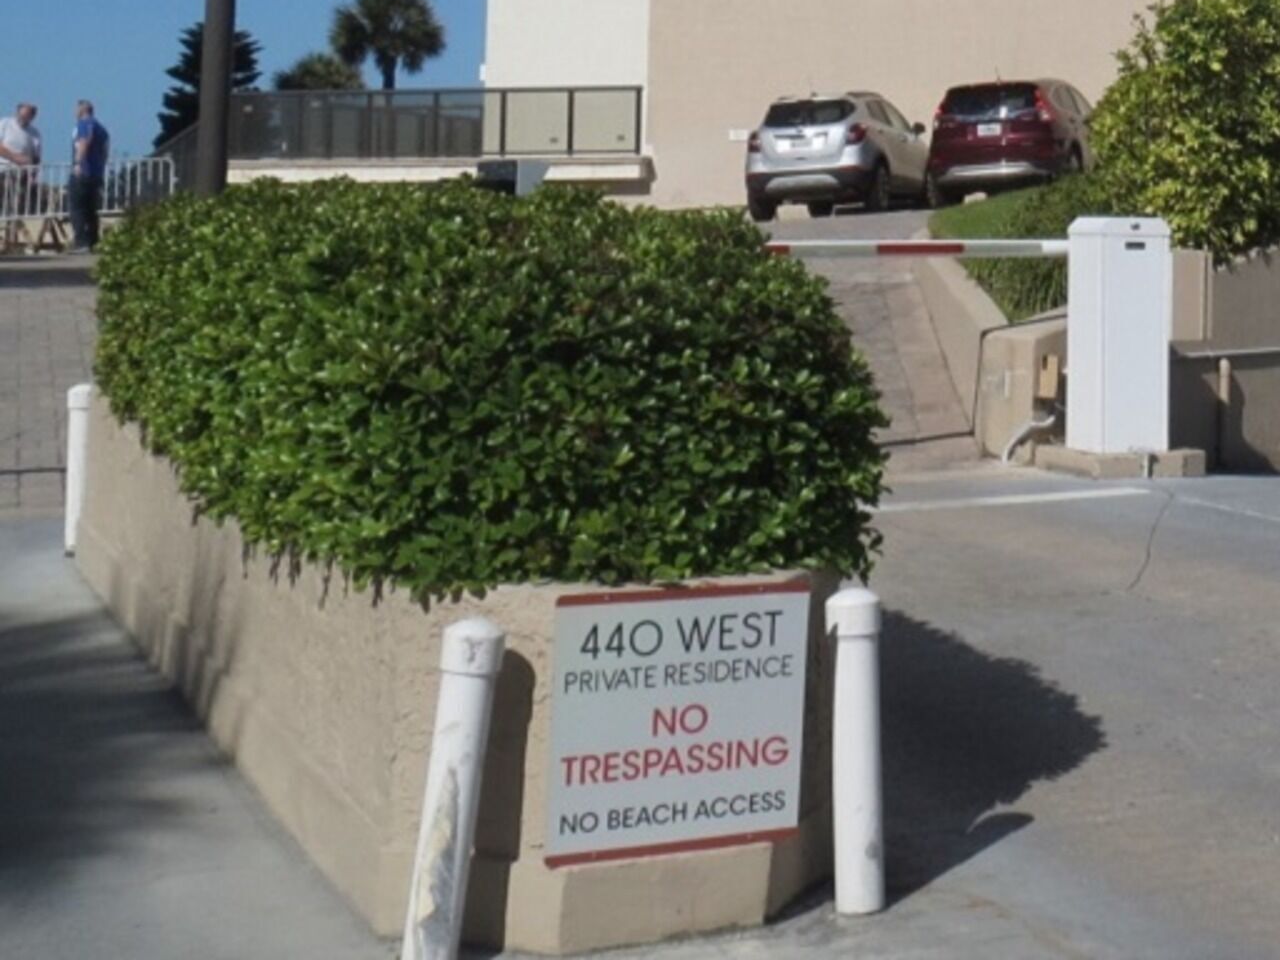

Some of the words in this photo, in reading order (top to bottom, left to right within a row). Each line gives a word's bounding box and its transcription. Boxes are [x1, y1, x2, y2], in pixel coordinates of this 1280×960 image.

[580, 619, 663, 660] 440
[676, 610, 784, 653] WEST
[563, 665, 657, 694] PRIVATE
[664, 654, 794, 686] RESIDENCE
[652, 704, 709, 737] NO
[561, 736, 790, 787] TRESPASSING
[559, 811, 600, 836] NO
[606, 801, 688, 831] BEACH
[693, 790, 786, 821] ACCESS
